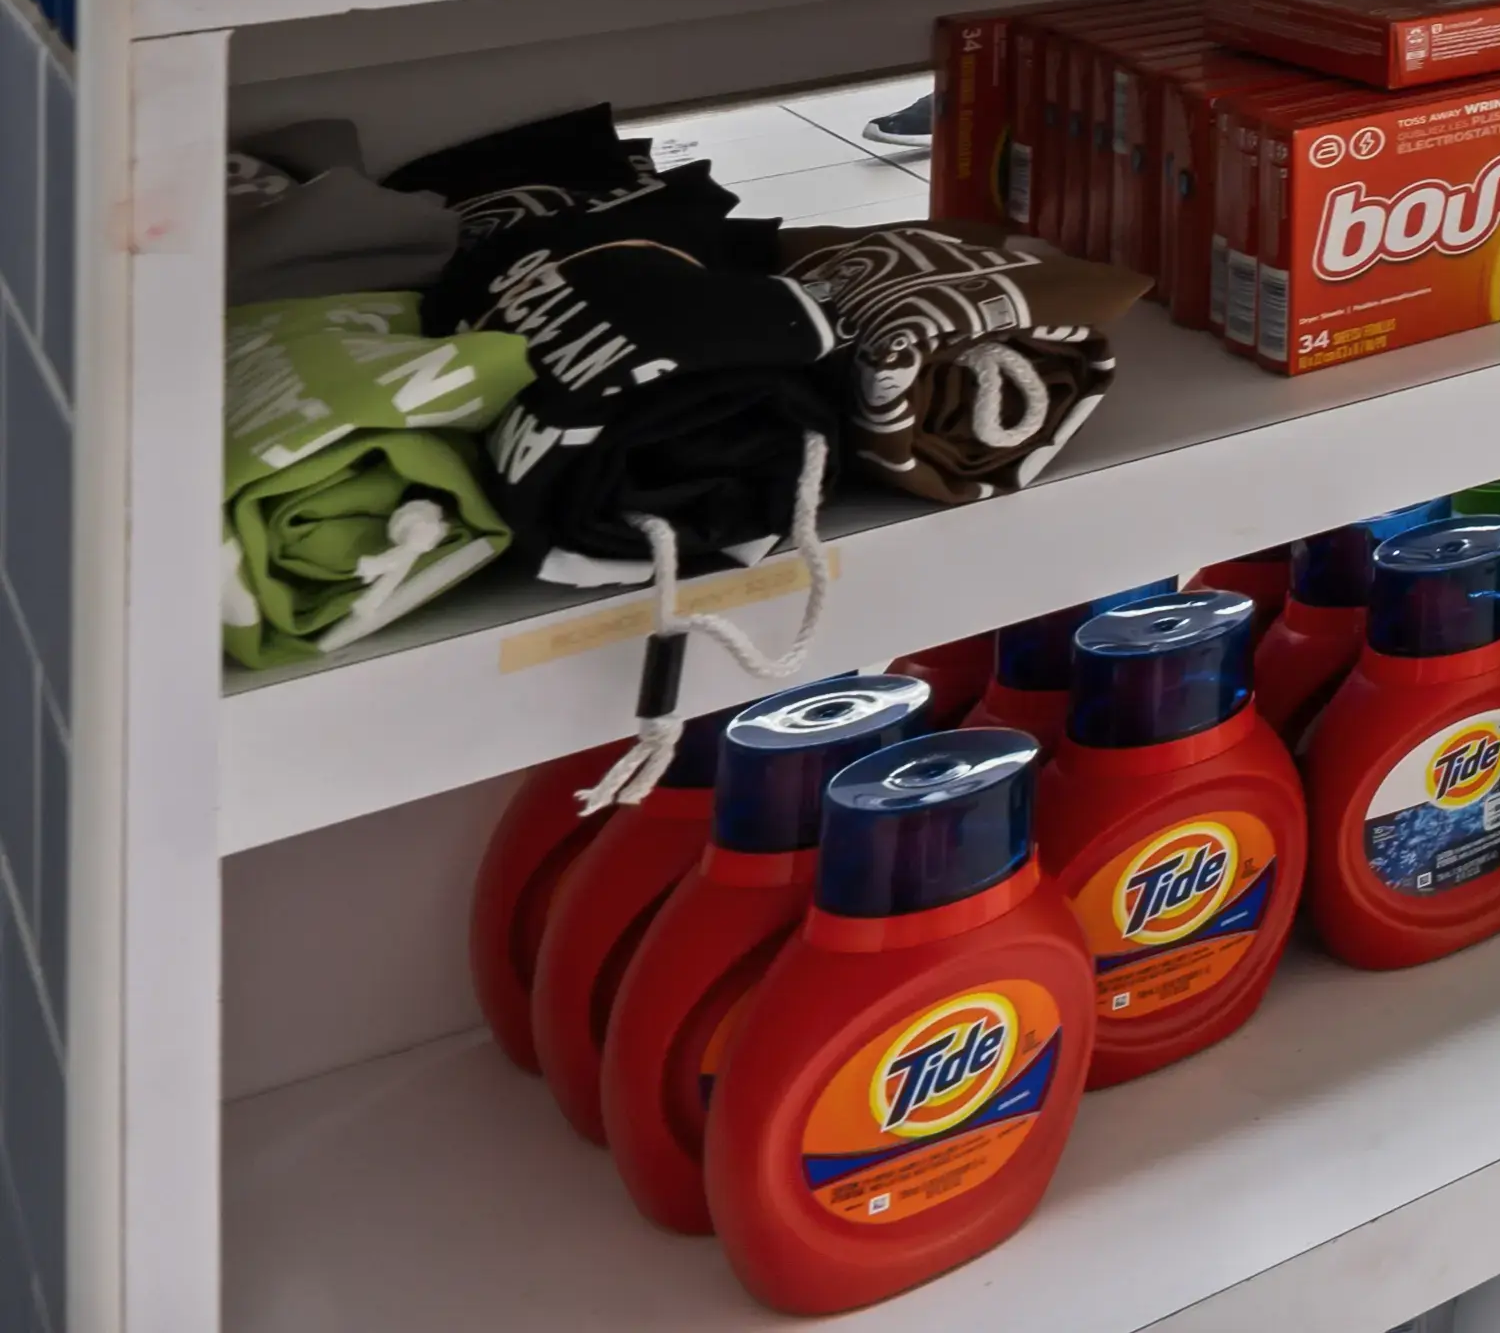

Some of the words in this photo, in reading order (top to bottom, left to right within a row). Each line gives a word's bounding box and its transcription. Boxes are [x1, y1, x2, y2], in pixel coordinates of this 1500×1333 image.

[1397, 114, 1427, 128] TOSS
[1428, 108, 1462, 123] AWAY
[1298, 330, 1331, 354] 34
[1122, 842, 1228, 939] Tide
[882, 1016, 1006, 1133] Tide
